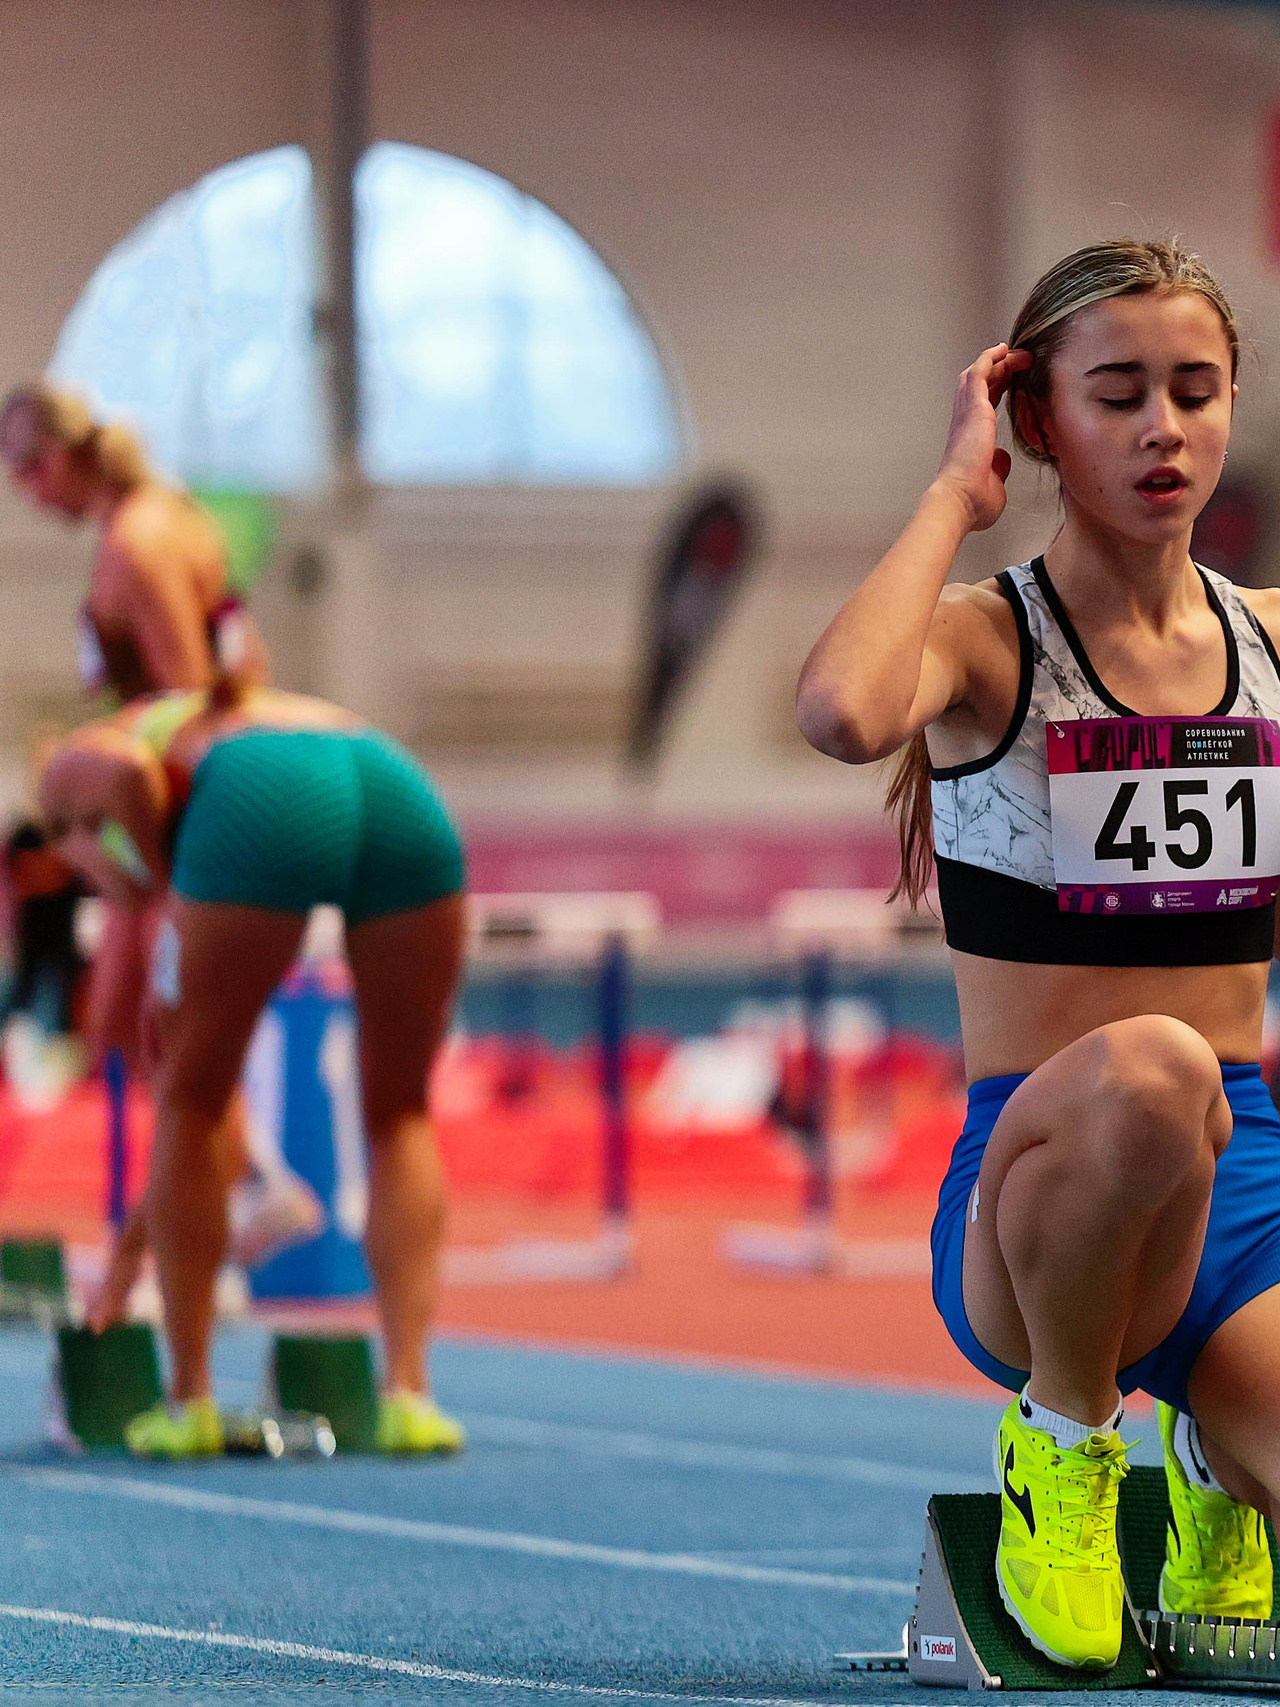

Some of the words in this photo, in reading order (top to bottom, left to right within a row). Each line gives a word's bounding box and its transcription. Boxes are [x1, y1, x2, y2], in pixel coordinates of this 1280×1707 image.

[1185, 728, 1246, 738] СОРЕВНОВАНИЯ
[1187, 752, 1229, 761] АТЛЕТИКЕ
[1094, 778, 1257, 872] 451
[931, 1640, 954, 1657] polanik
